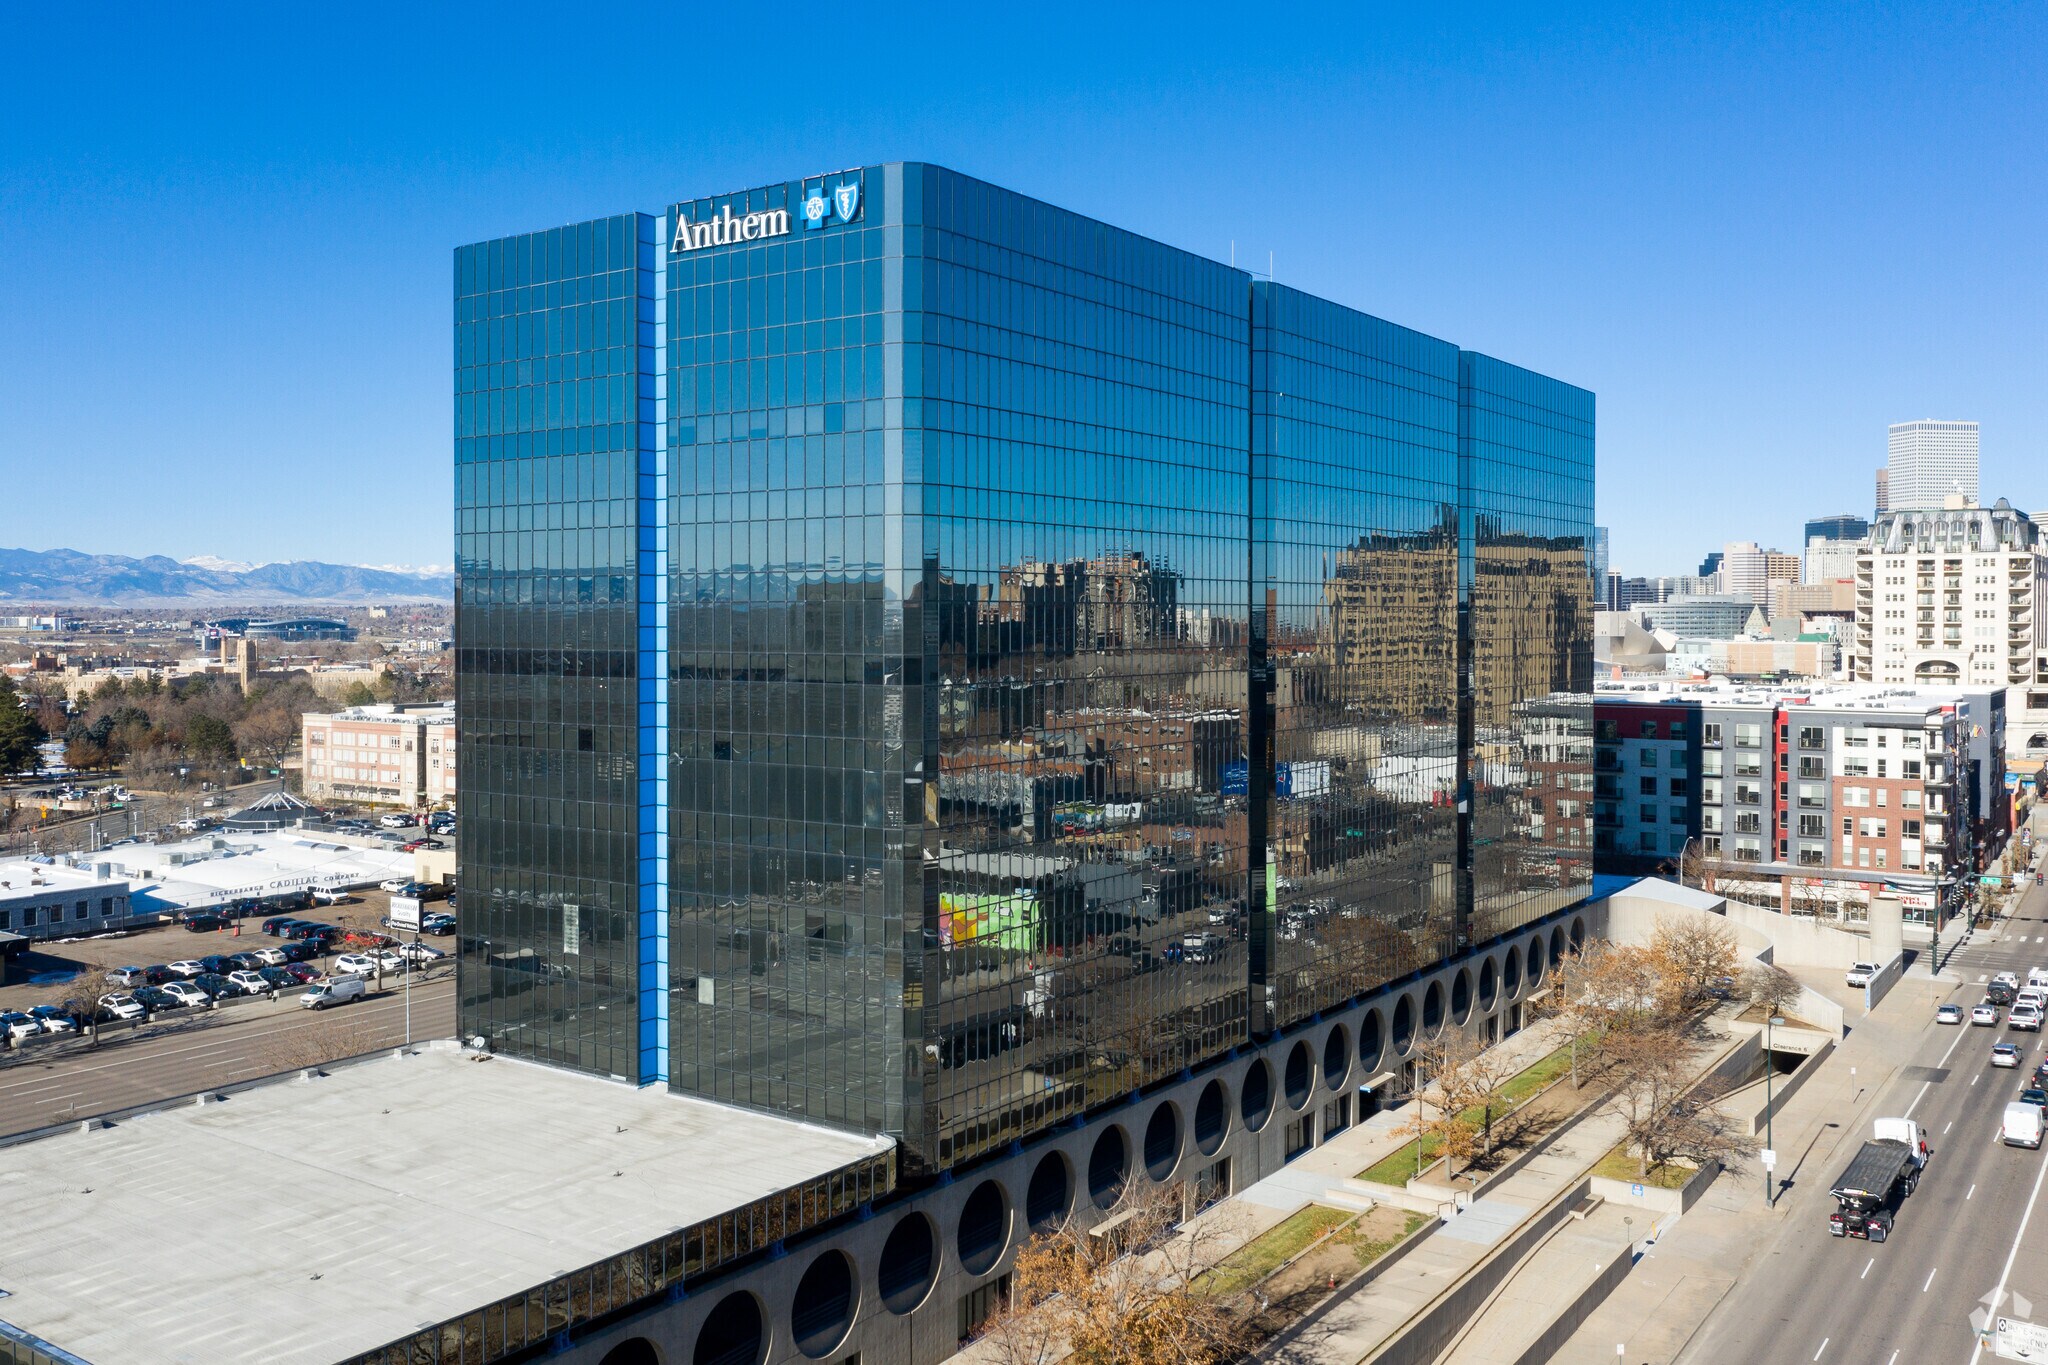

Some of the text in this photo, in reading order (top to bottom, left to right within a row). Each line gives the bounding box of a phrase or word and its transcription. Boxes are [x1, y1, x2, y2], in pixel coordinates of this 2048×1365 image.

[669, 205, 790, 253] Anthem
[269, 876, 319, 889] CADILLAC
[324, 872, 360, 882] COMPANY
